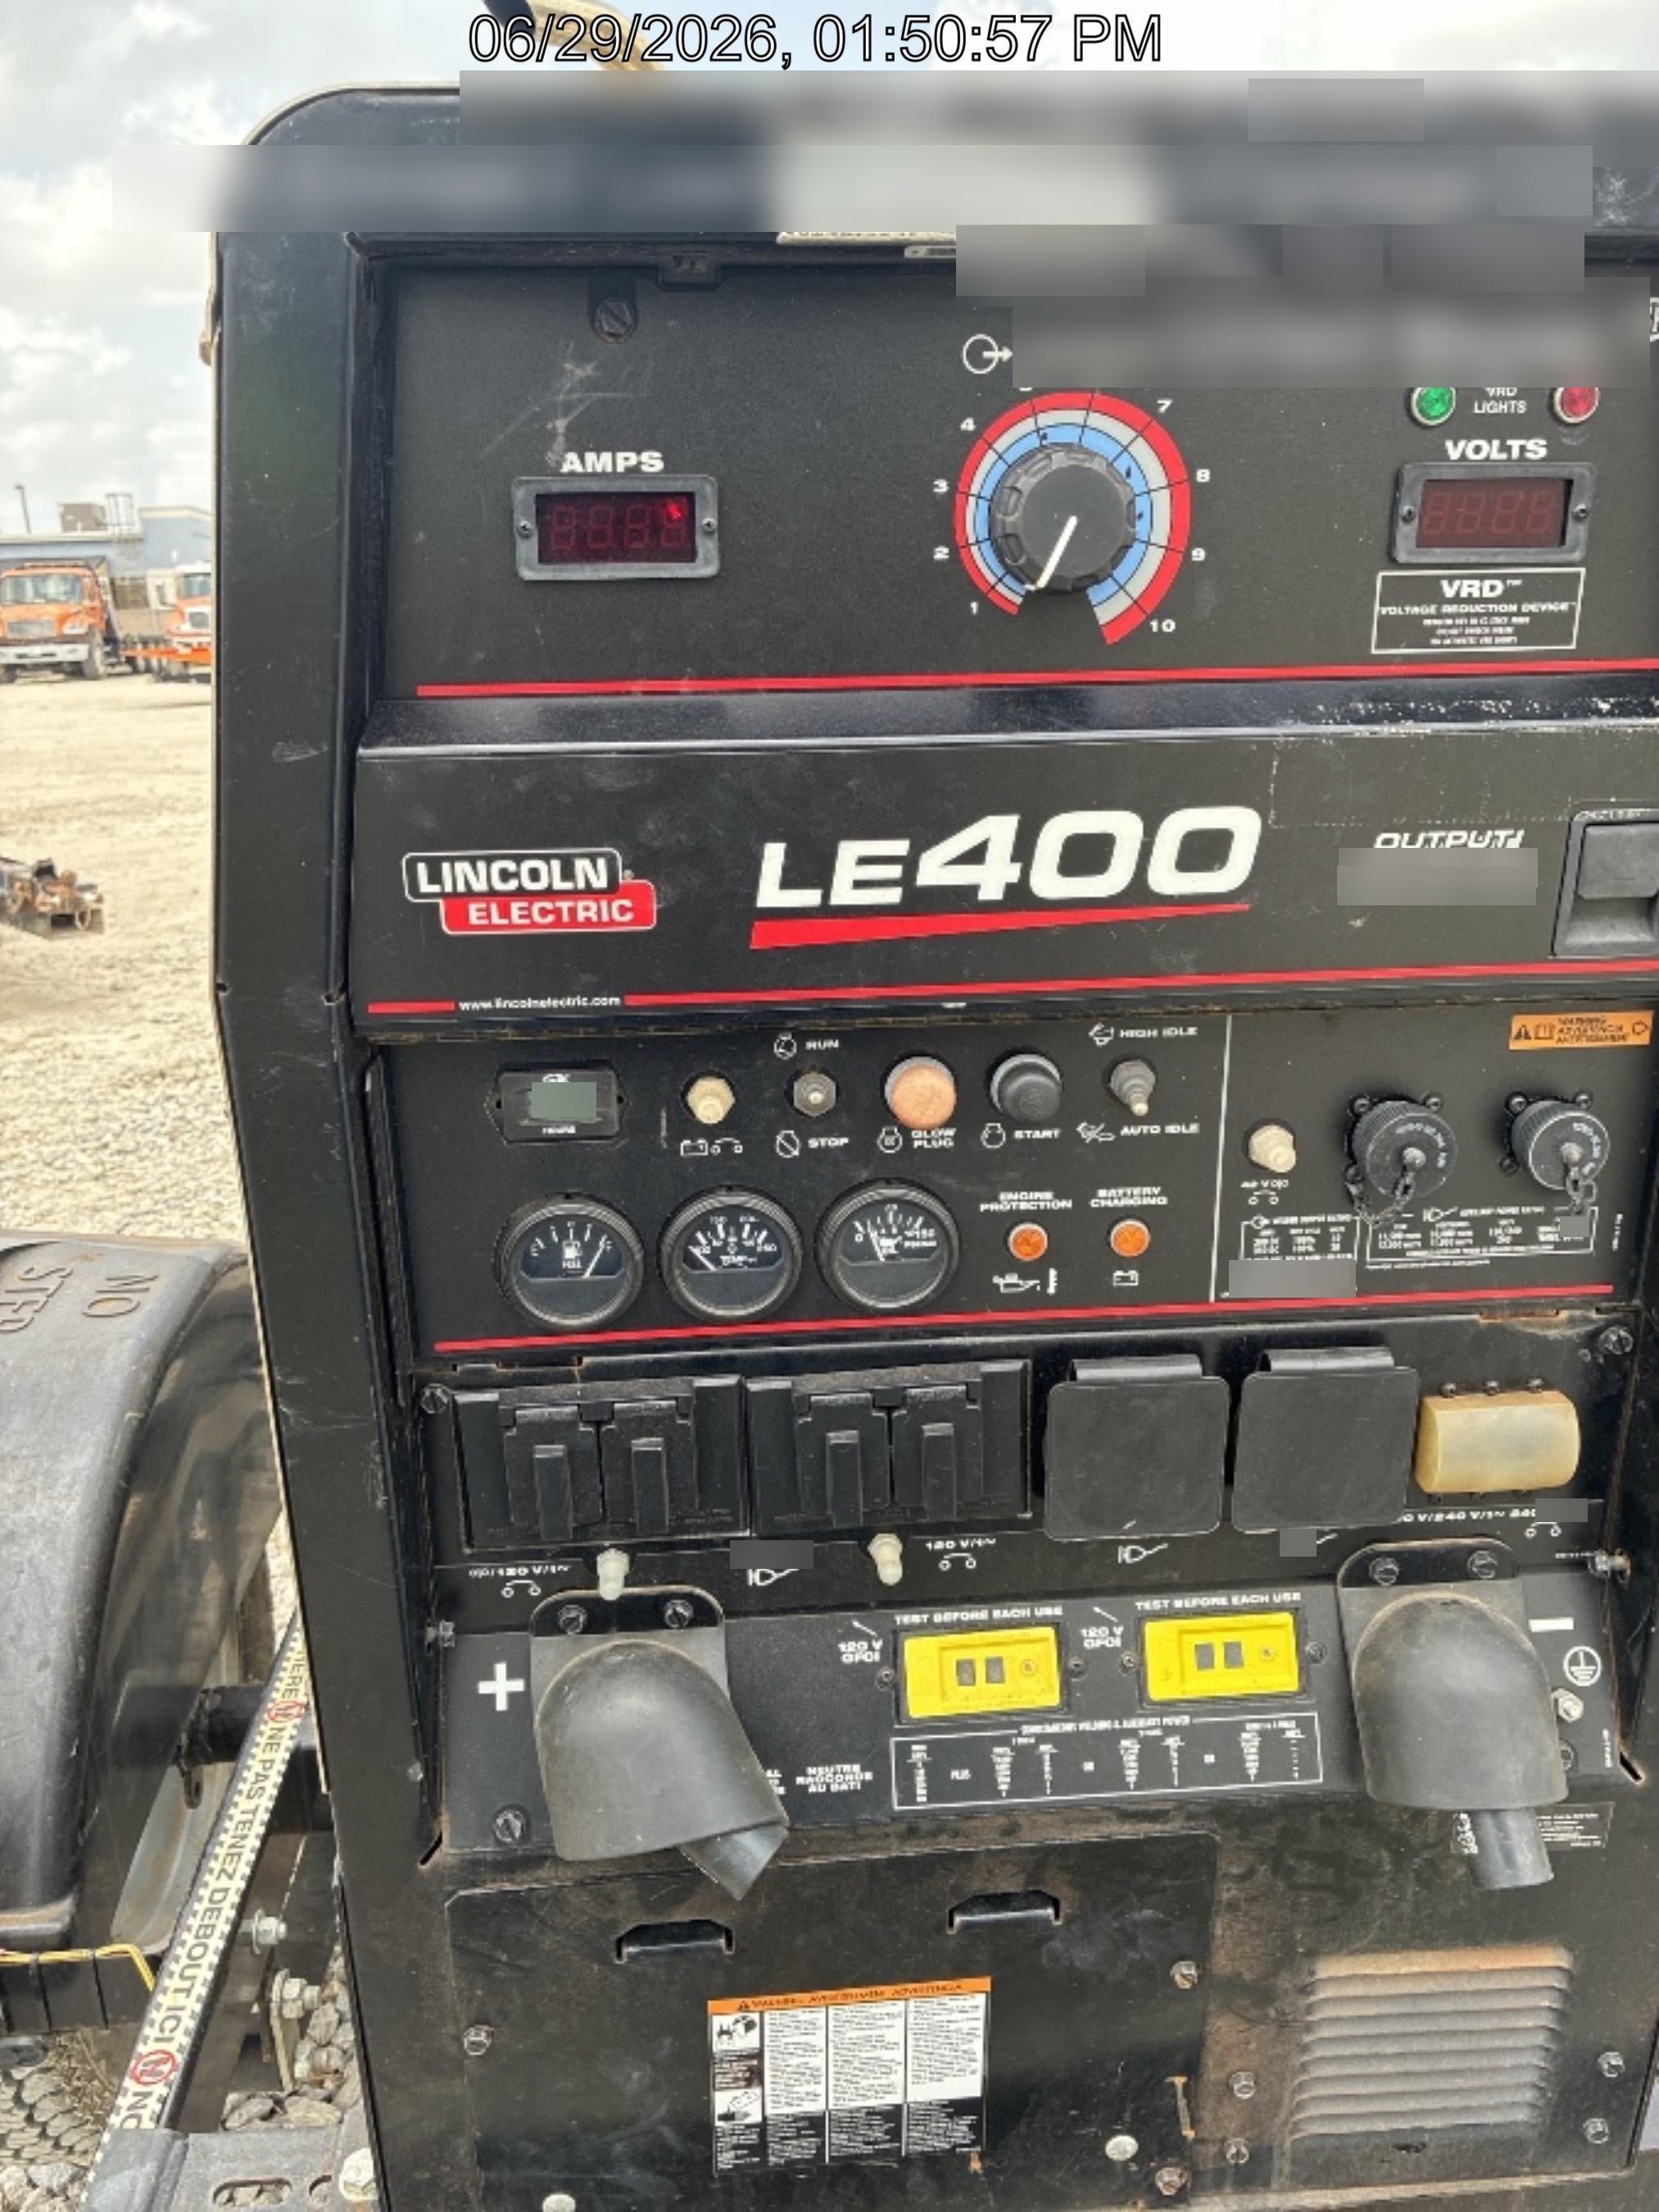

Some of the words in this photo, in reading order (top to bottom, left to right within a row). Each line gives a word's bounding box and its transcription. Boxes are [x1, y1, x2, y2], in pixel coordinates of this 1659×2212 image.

[1157, 399, 1173, 413] 7
[1474, 400, 1527, 414] LIGHTS
[960, 418, 977, 432] 4
[1445, 437, 1548, 460] VOLTS
[560, 450, 665, 474] AMPS
[1195, 469, 1211, 483] 8
[933, 478, 949, 493] 3
[933, 546, 950, 560] 2
[1191, 548, 1206, 562] 9
[970, 601, 978, 614] 1
[1149, 619, 1176, 633] 10
[755, 805, 1262, 908] LE400
[417, 857, 609, 894] LINCOLN
[468, 898, 635, 926] ELECTRIC
[458, 995, 622, 1012] www.lincolnelectric.com
[1119, 1029, 1158, 1039] HIGH
[1162, 1027, 1198, 1036] IDLE
[805, 1039, 840, 1049] RUN
[911, 1127, 957, 1139] GLOW
[1013, 1128, 1061, 1140] START
[1120, 1124, 1160, 1135] AUTO
[1164, 1123, 1200, 1135] IDLE
[808, 1137, 850, 1148] STOP
[912, 1138, 955, 1149] PLUG
[999, 1190, 1055, 1200] ENGINE
[1096, 1186, 1162, 1198] BATTERY
[980, 1199, 1073, 1213] PROTECTION
[1089, 1195, 1169, 1208] CHARGING
[82, 1273, 159, 1317] NO
[1135, 1598, 1171, 1611] TEST
[1173, 1596, 1228, 1608] BEFORE
[1231, 1594, 1270, 1607] EACH
[1273, 1592, 1302, 1602] USE
[895, 1613, 930, 1625] TEST
[933, 1610, 989, 1623] BEFORE
[992, 1607, 1031, 1619] EACH
[1034, 1605, 1063, 1616] USE
[1081, 1626, 1109, 1639] 120
[1113, 1625, 1124, 1637] V
[838, 1640, 868, 1653] 120
[872, 1639, 883, 1651] V
[261, 1726, 287, 1753] NE
[246, 1759, 274, 1801] PAS
[215, 1805, 261, 1881] TENEZ
[153, 2006, 187, 2043] ICI
